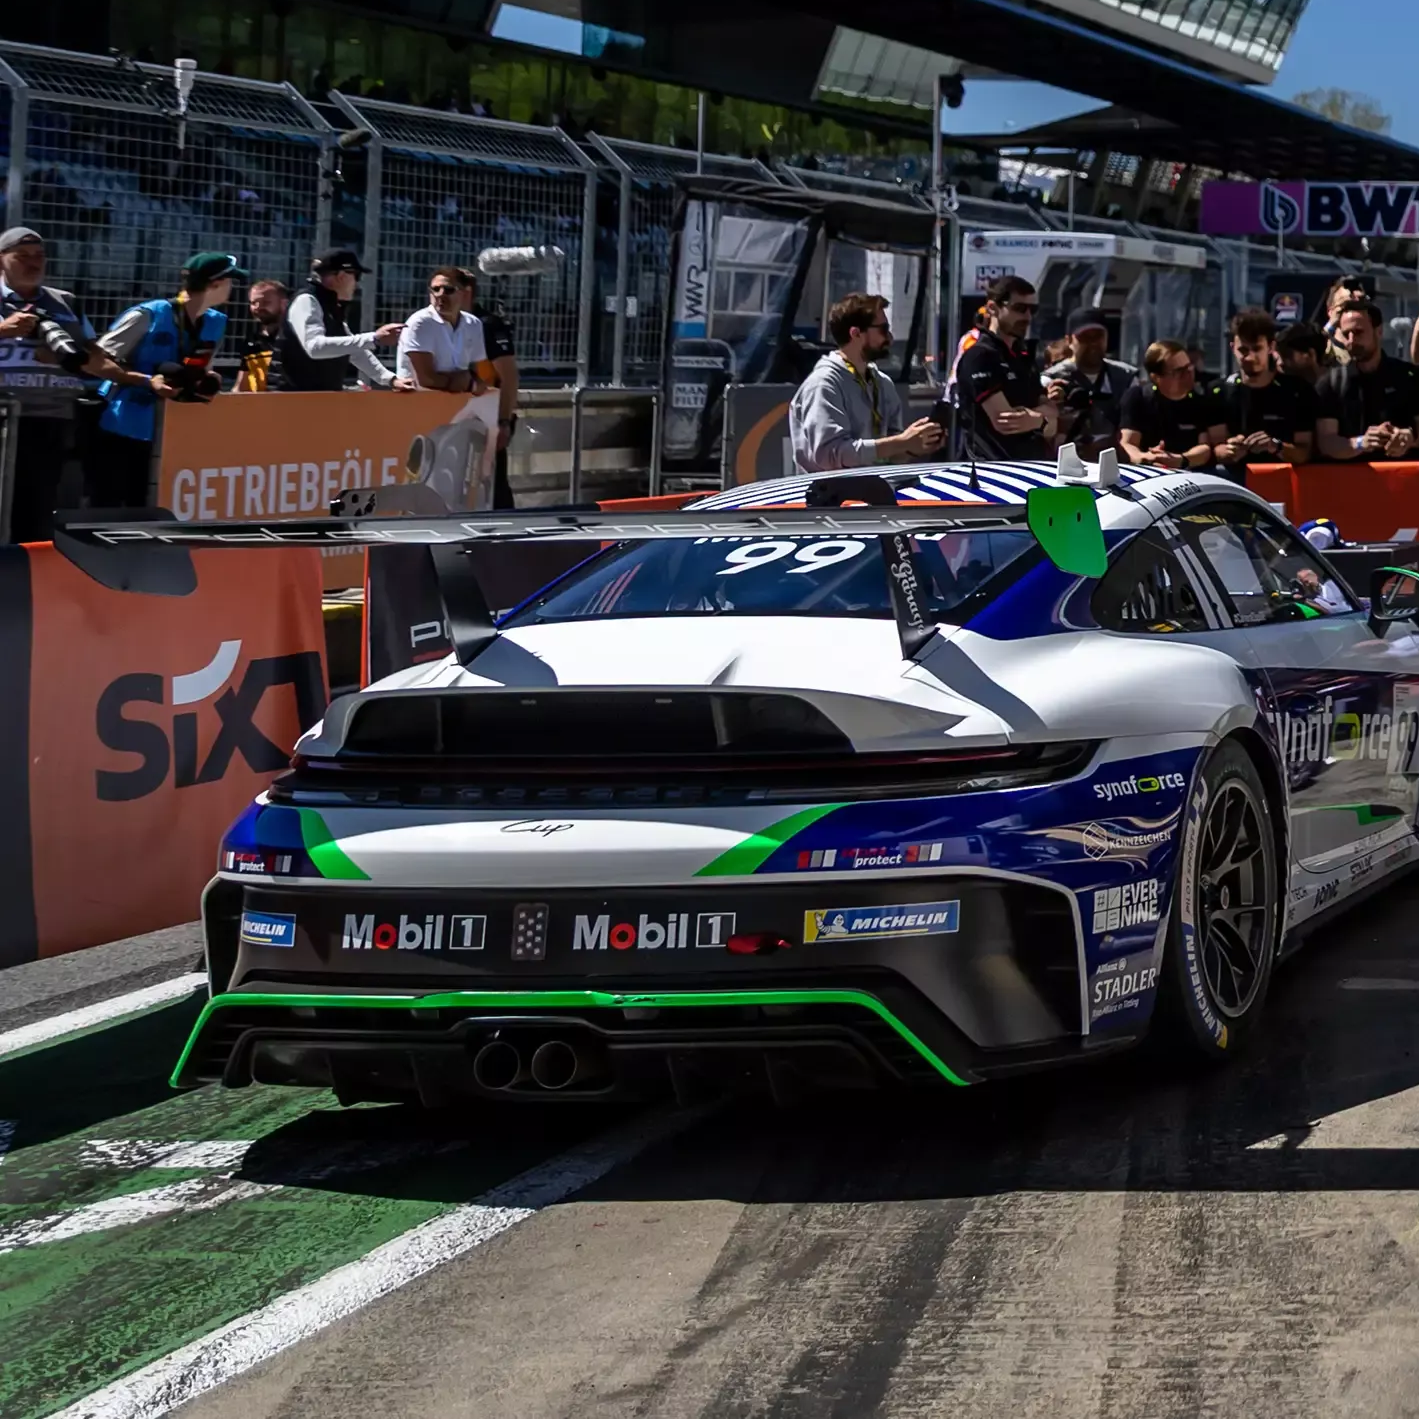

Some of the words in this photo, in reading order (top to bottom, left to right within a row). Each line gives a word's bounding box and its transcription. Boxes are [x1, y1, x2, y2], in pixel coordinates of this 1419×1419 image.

[91, 527, 443, 545] Proton
[460, 514, 1013, 538] Competition
[716, 540, 865, 576] 99
[1092, 771, 1186, 802] synaforce
[500, 818, 575, 838] Cup
[239, 862, 265, 873] protect
[854, 851, 903, 869] protect
[1122, 878, 1158, 906] EVER
[850, 911, 948, 931] MICHELIN
[1121, 899, 1160, 929] NINE
[342, 913, 444, 951] Mobil
[572, 913, 689, 951] Mobil
[1094, 967, 1158, 1004] STADLER
